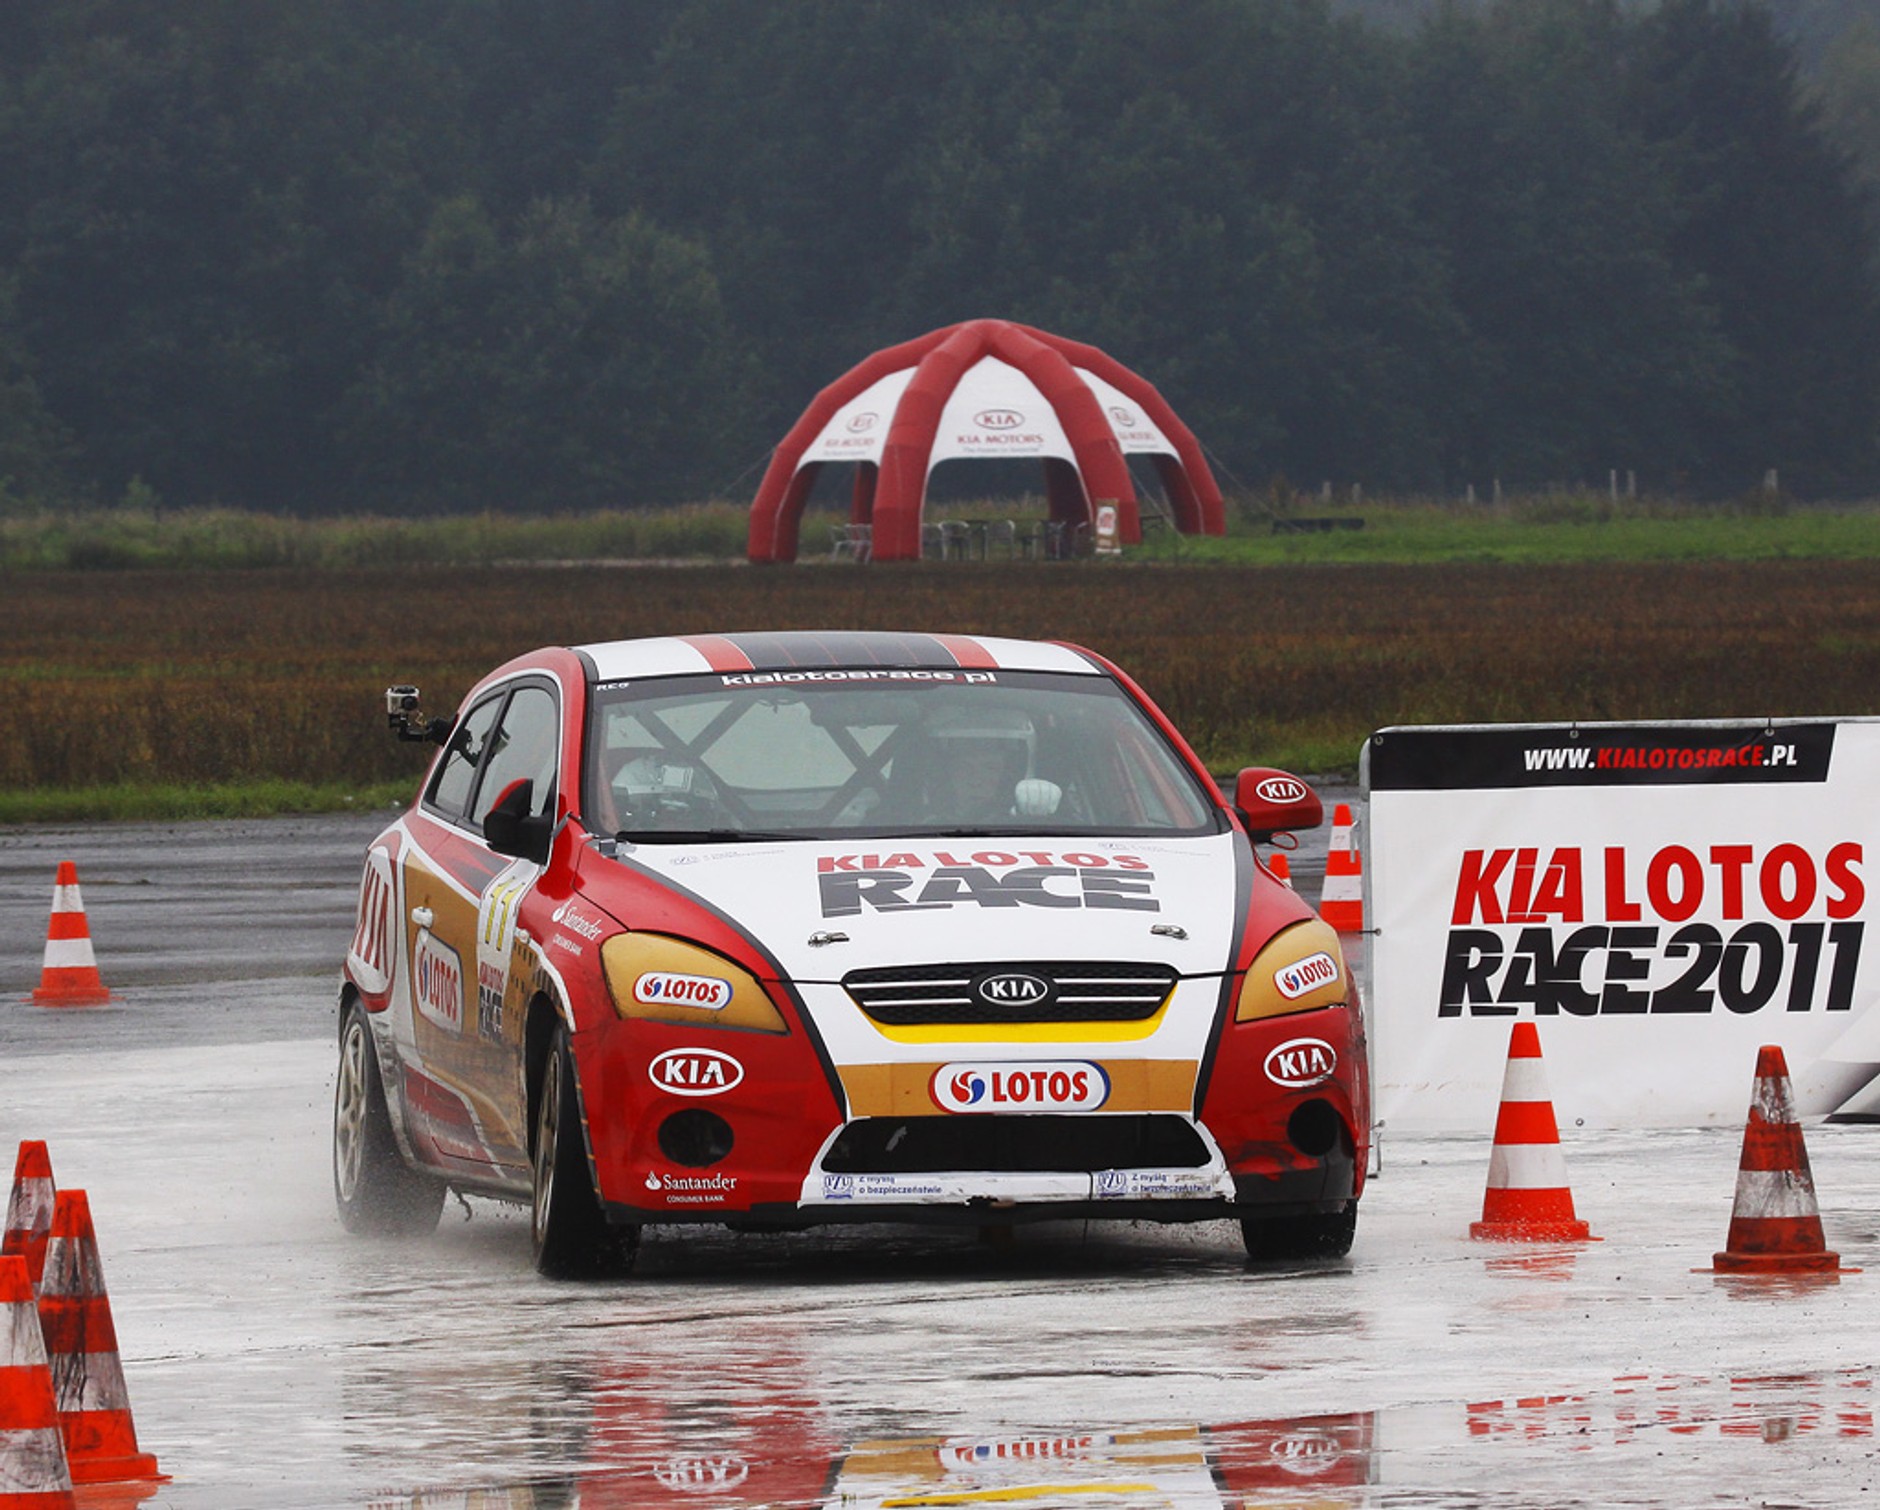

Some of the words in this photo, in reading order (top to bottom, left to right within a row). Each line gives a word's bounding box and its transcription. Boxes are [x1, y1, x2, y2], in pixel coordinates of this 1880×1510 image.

[983, 415, 1017, 425] KIA
[957, 435, 981, 444] KIA
[1524, 744, 1798, 771] WWW.KIALOTOSRACE.PL
[1265, 783, 1300, 798] KIA
[817, 852, 925, 873] KIA
[933, 851, 1150, 871] LOTOS
[818, 866, 1162, 919] RACE
[1450, 847, 1584, 926] KIA
[1604, 842, 1866, 923] LOTOS
[352, 860, 390, 981] KIA
[560, 905, 602, 941] Santander
[1296, 957, 1334, 987] LOTOS
[429, 951, 458, 1023] LOTOS
[663, 978, 721, 1003] LOTOS
[991, 980, 1038, 998] KIA
[664, 1058, 726, 1086] KIA
[1277, 1047, 1328, 1079] KIA
[991, 1070, 1089, 1103] LOTOS
[662, 1172, 738, 1191] Santander
[859, 1186, 866, 1194] o
